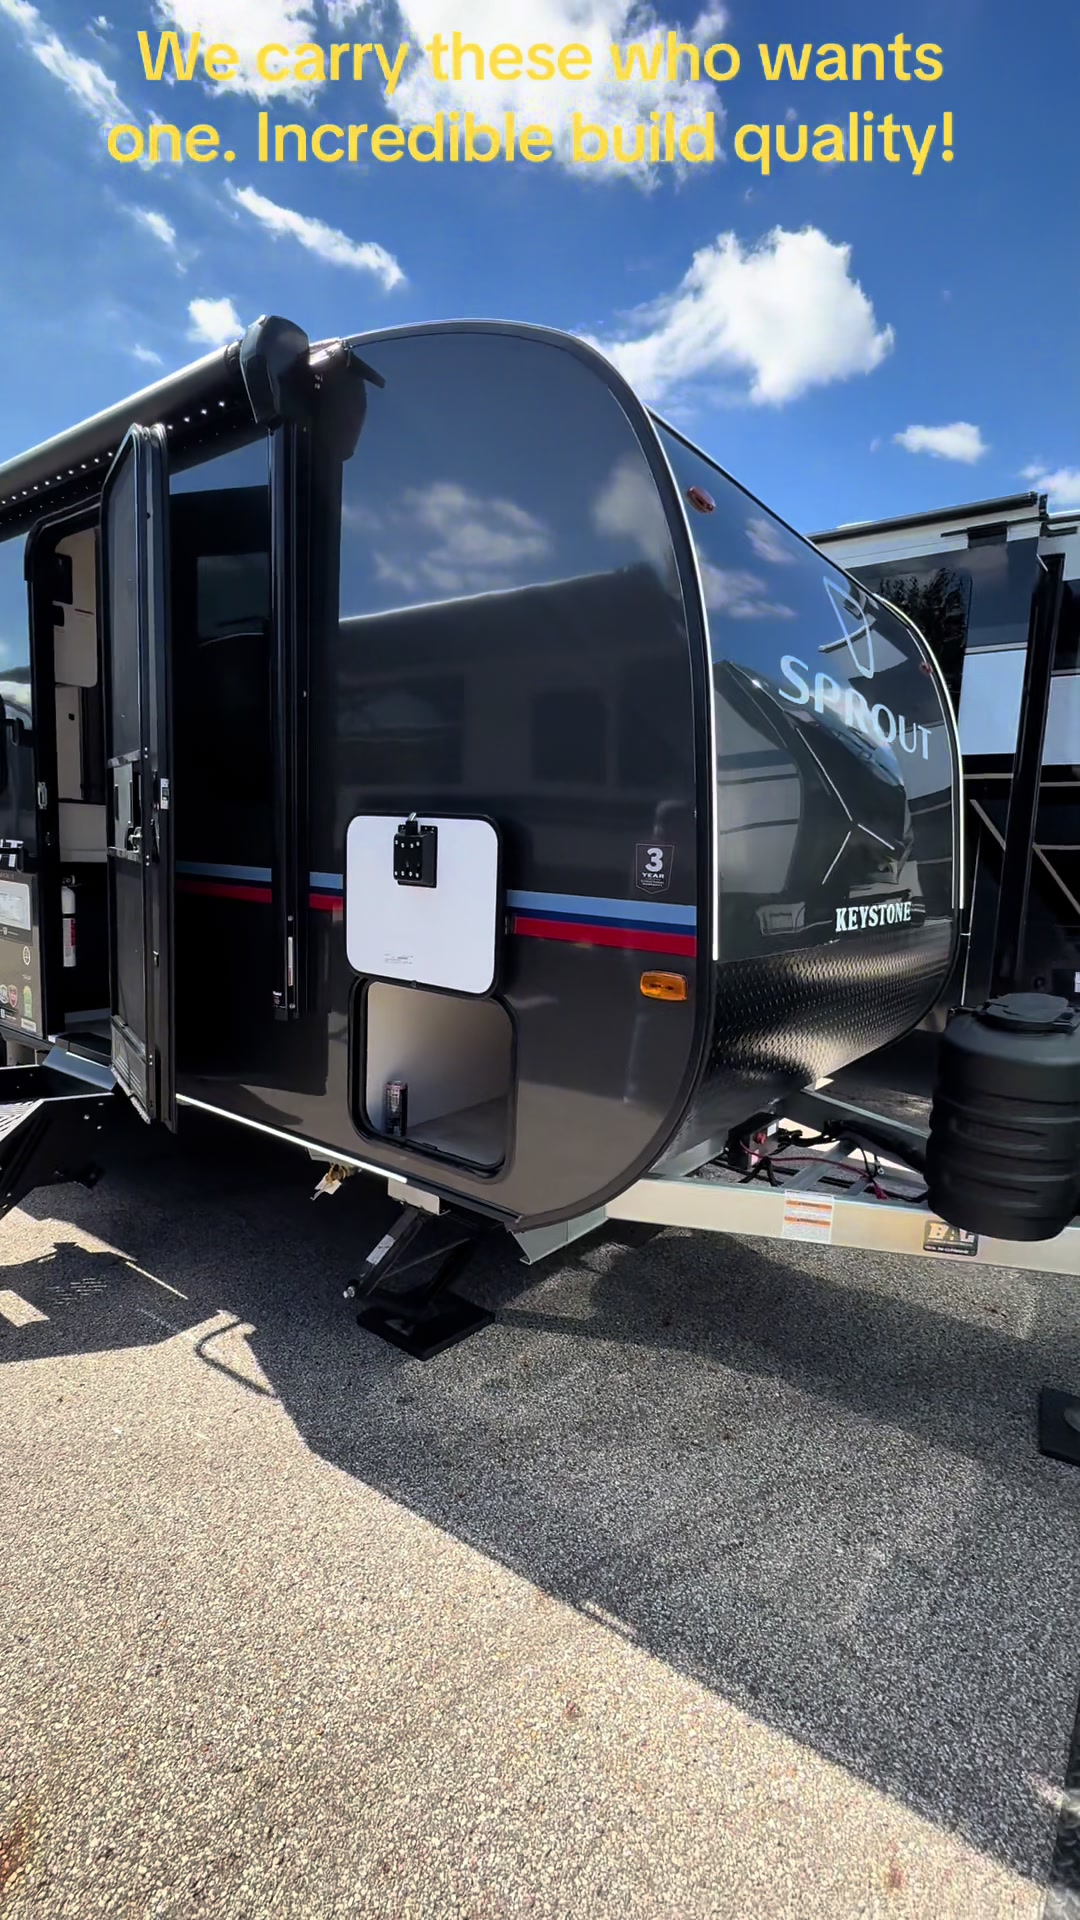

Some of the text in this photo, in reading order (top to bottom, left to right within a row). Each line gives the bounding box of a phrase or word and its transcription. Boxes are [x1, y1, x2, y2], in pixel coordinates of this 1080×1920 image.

[778, 654, 932, 760] SPROUT
[645, 847, 664, 873] 3
[835, 902, 912, 932] KEYSTONE
